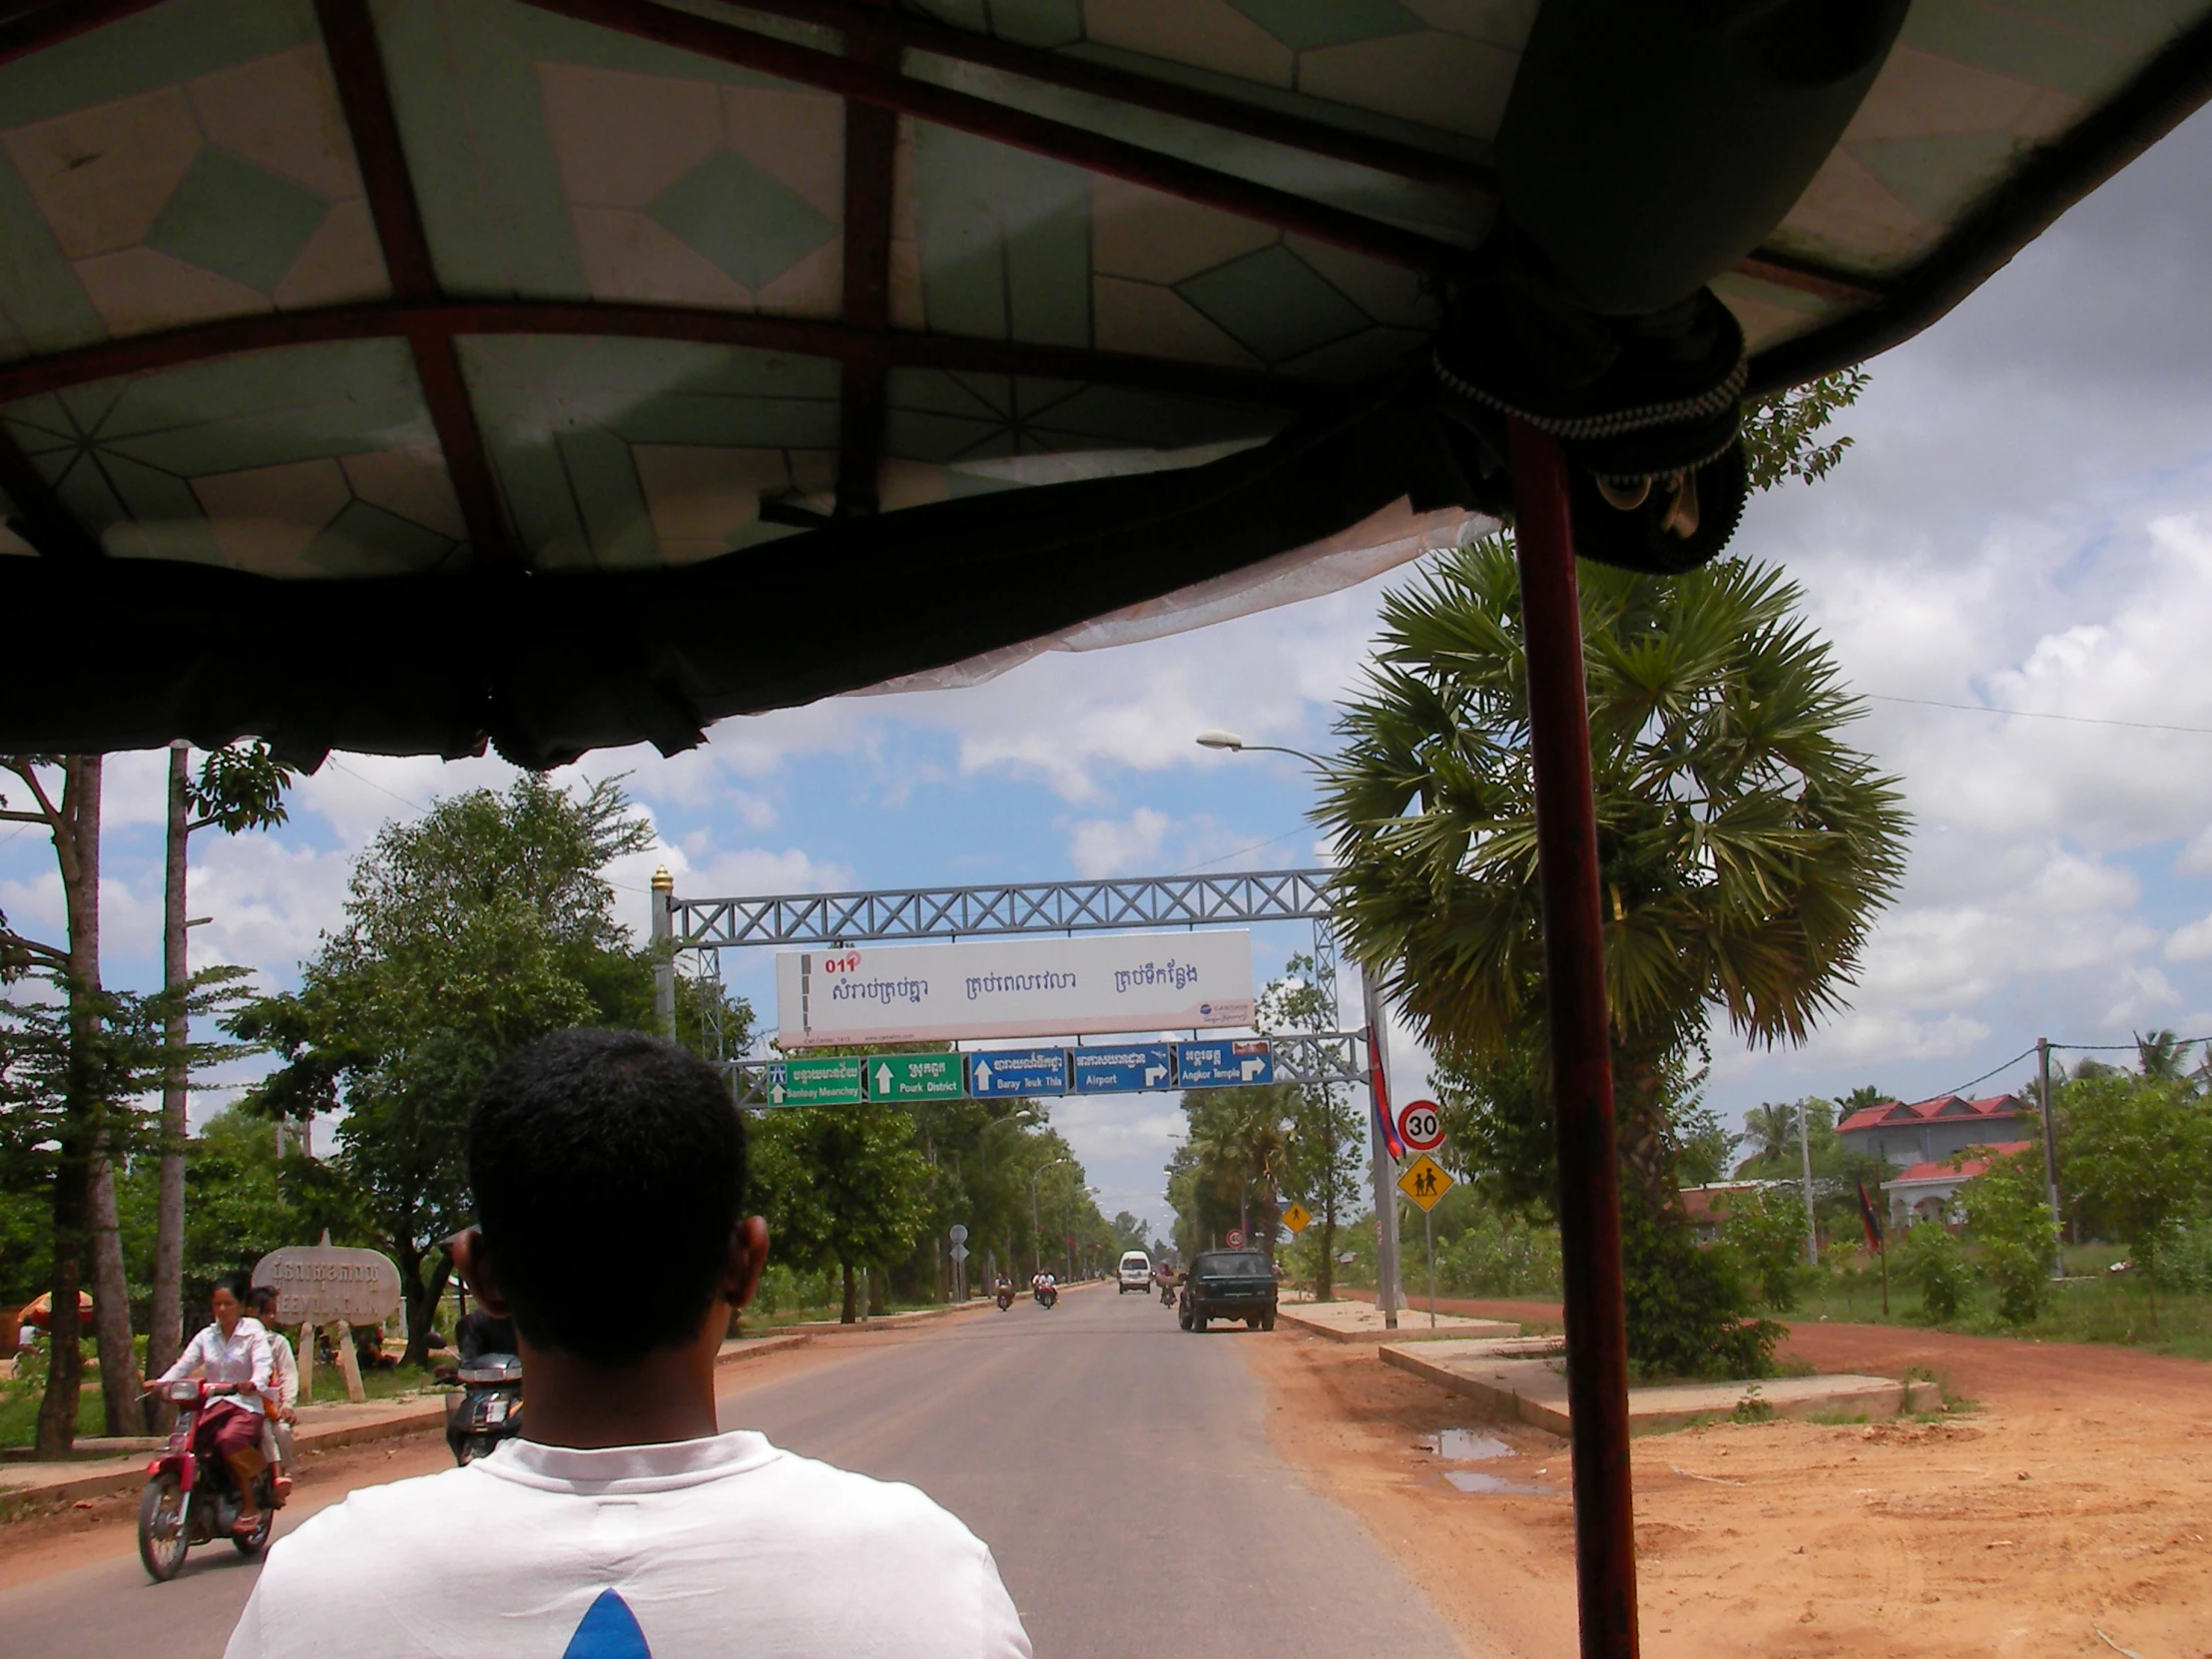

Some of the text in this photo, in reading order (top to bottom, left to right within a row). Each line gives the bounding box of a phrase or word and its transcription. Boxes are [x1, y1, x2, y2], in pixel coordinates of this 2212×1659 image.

[826, 958, 854, 973] 011
[965, 971, 1077, 1000] គ្រប់ពេលវេលា
[1086, 1074, 1117, 1087] Airport
[1182, 1067, 1241, 1082] Angkor Temple
[926, 1080, 958, 1092] District
[996, 1078, 1021, 1091] Baray
[1408, 1114, 1437, 1137] 30
